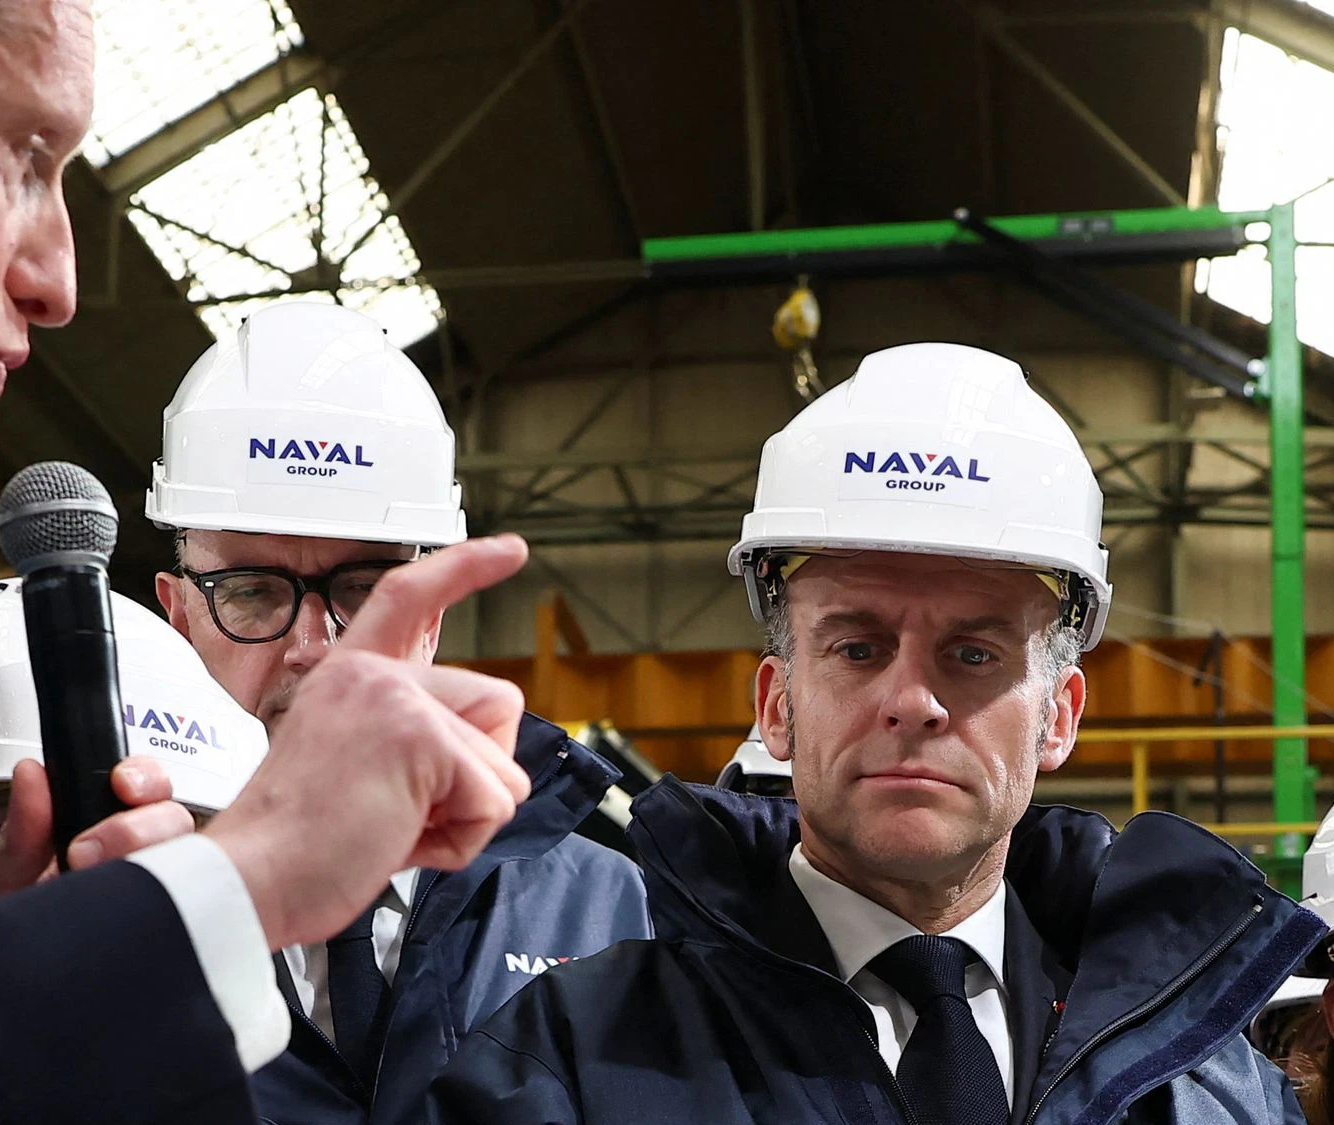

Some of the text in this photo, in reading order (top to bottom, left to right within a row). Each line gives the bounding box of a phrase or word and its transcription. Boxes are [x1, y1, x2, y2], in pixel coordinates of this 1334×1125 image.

[249, 438, 374, 467] NAVAL
[286, 465, 338, 477] GROUP
[843, 451, 991, 482] NAVAL
[885, 479, 946, 492] GROUP
[149, 736, 197, 755] GROUP
